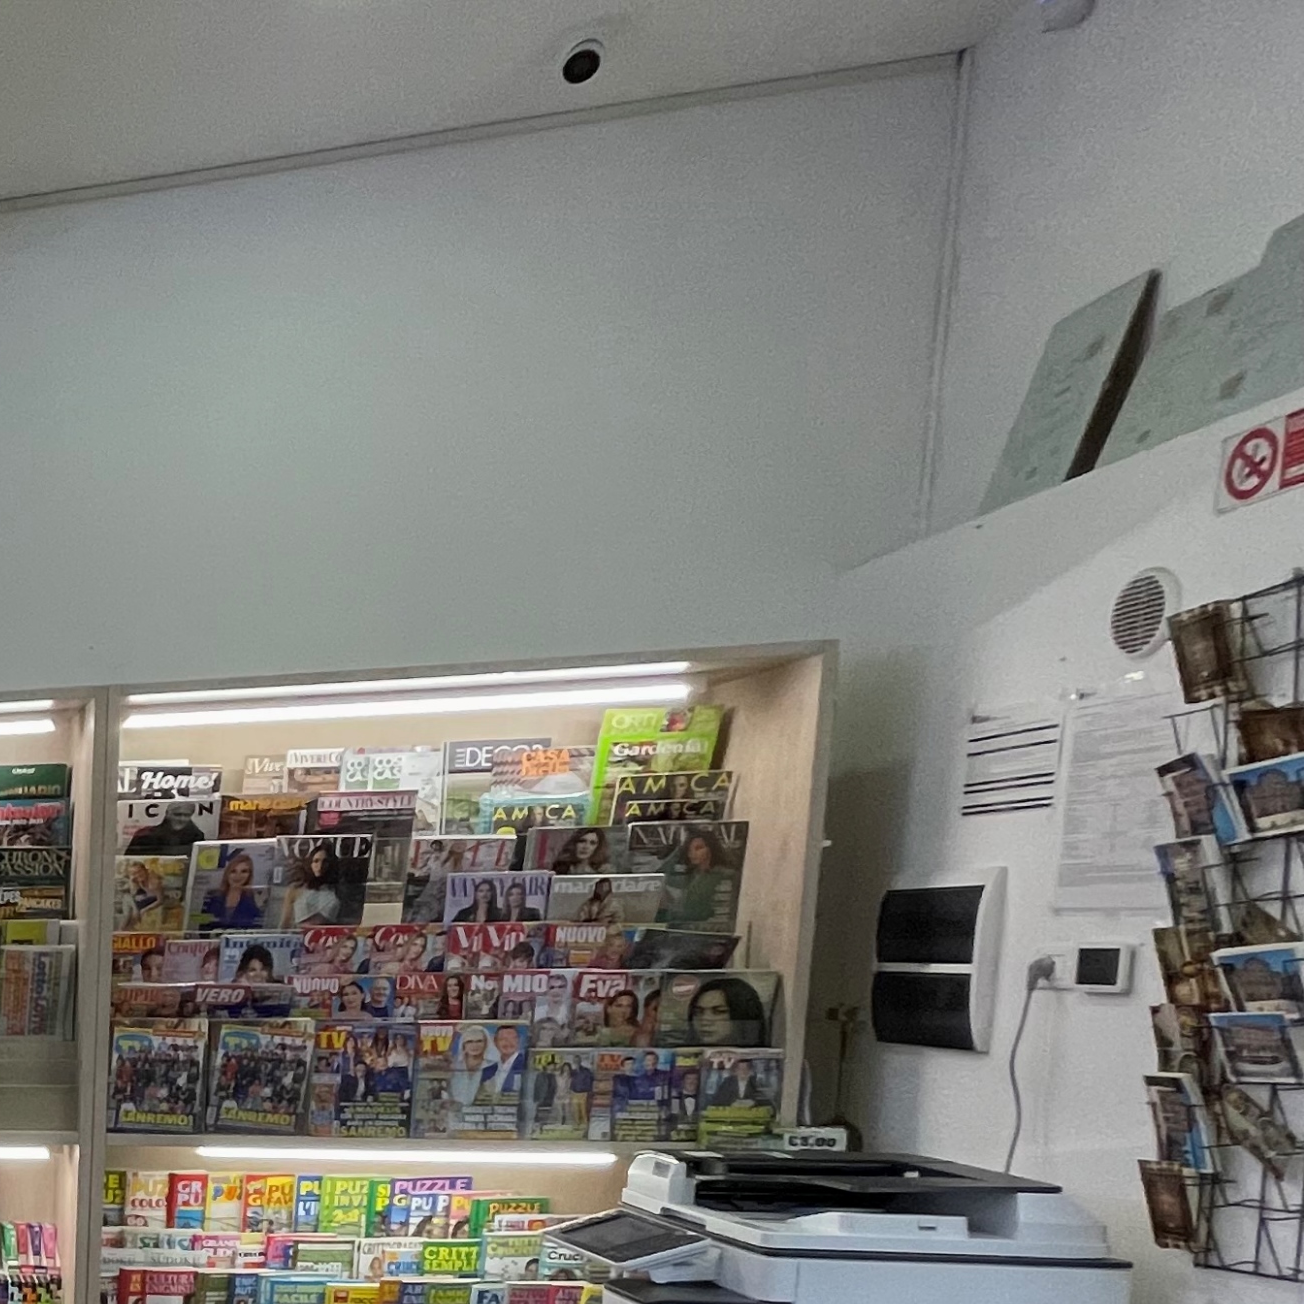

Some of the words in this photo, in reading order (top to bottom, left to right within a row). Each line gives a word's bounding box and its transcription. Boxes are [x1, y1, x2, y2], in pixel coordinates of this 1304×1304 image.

[613, 739, 703, 755] Gardenia
[142, 770, 218, 790] Home!
[618, 773, 731, 795] AMCA
[128, 801, 214, 818] ICN
[493, 804, 577, 821] AMCA
[625, 802, 715, 818] AMCA
[556, 926, 606, 943] NUOVO
[112, 937, 156, 950] GIALLO
[294, 977, 339, 994] NUOVO
[396, 974, 439, 990] DIVA
[503, 974, 549, 993] MIO
[579, 975, 626, 998] Eva
[195, 988, 246, 1003] VERO
[319, 1031, 347, 1049] TV
[421, 1035, 452, 1051] TV
[340, 1126, 406, 1137] SANREMO
[177, 1180, 202, 1193] GR
[394, 1179, 468, 1195] PUZZLE
